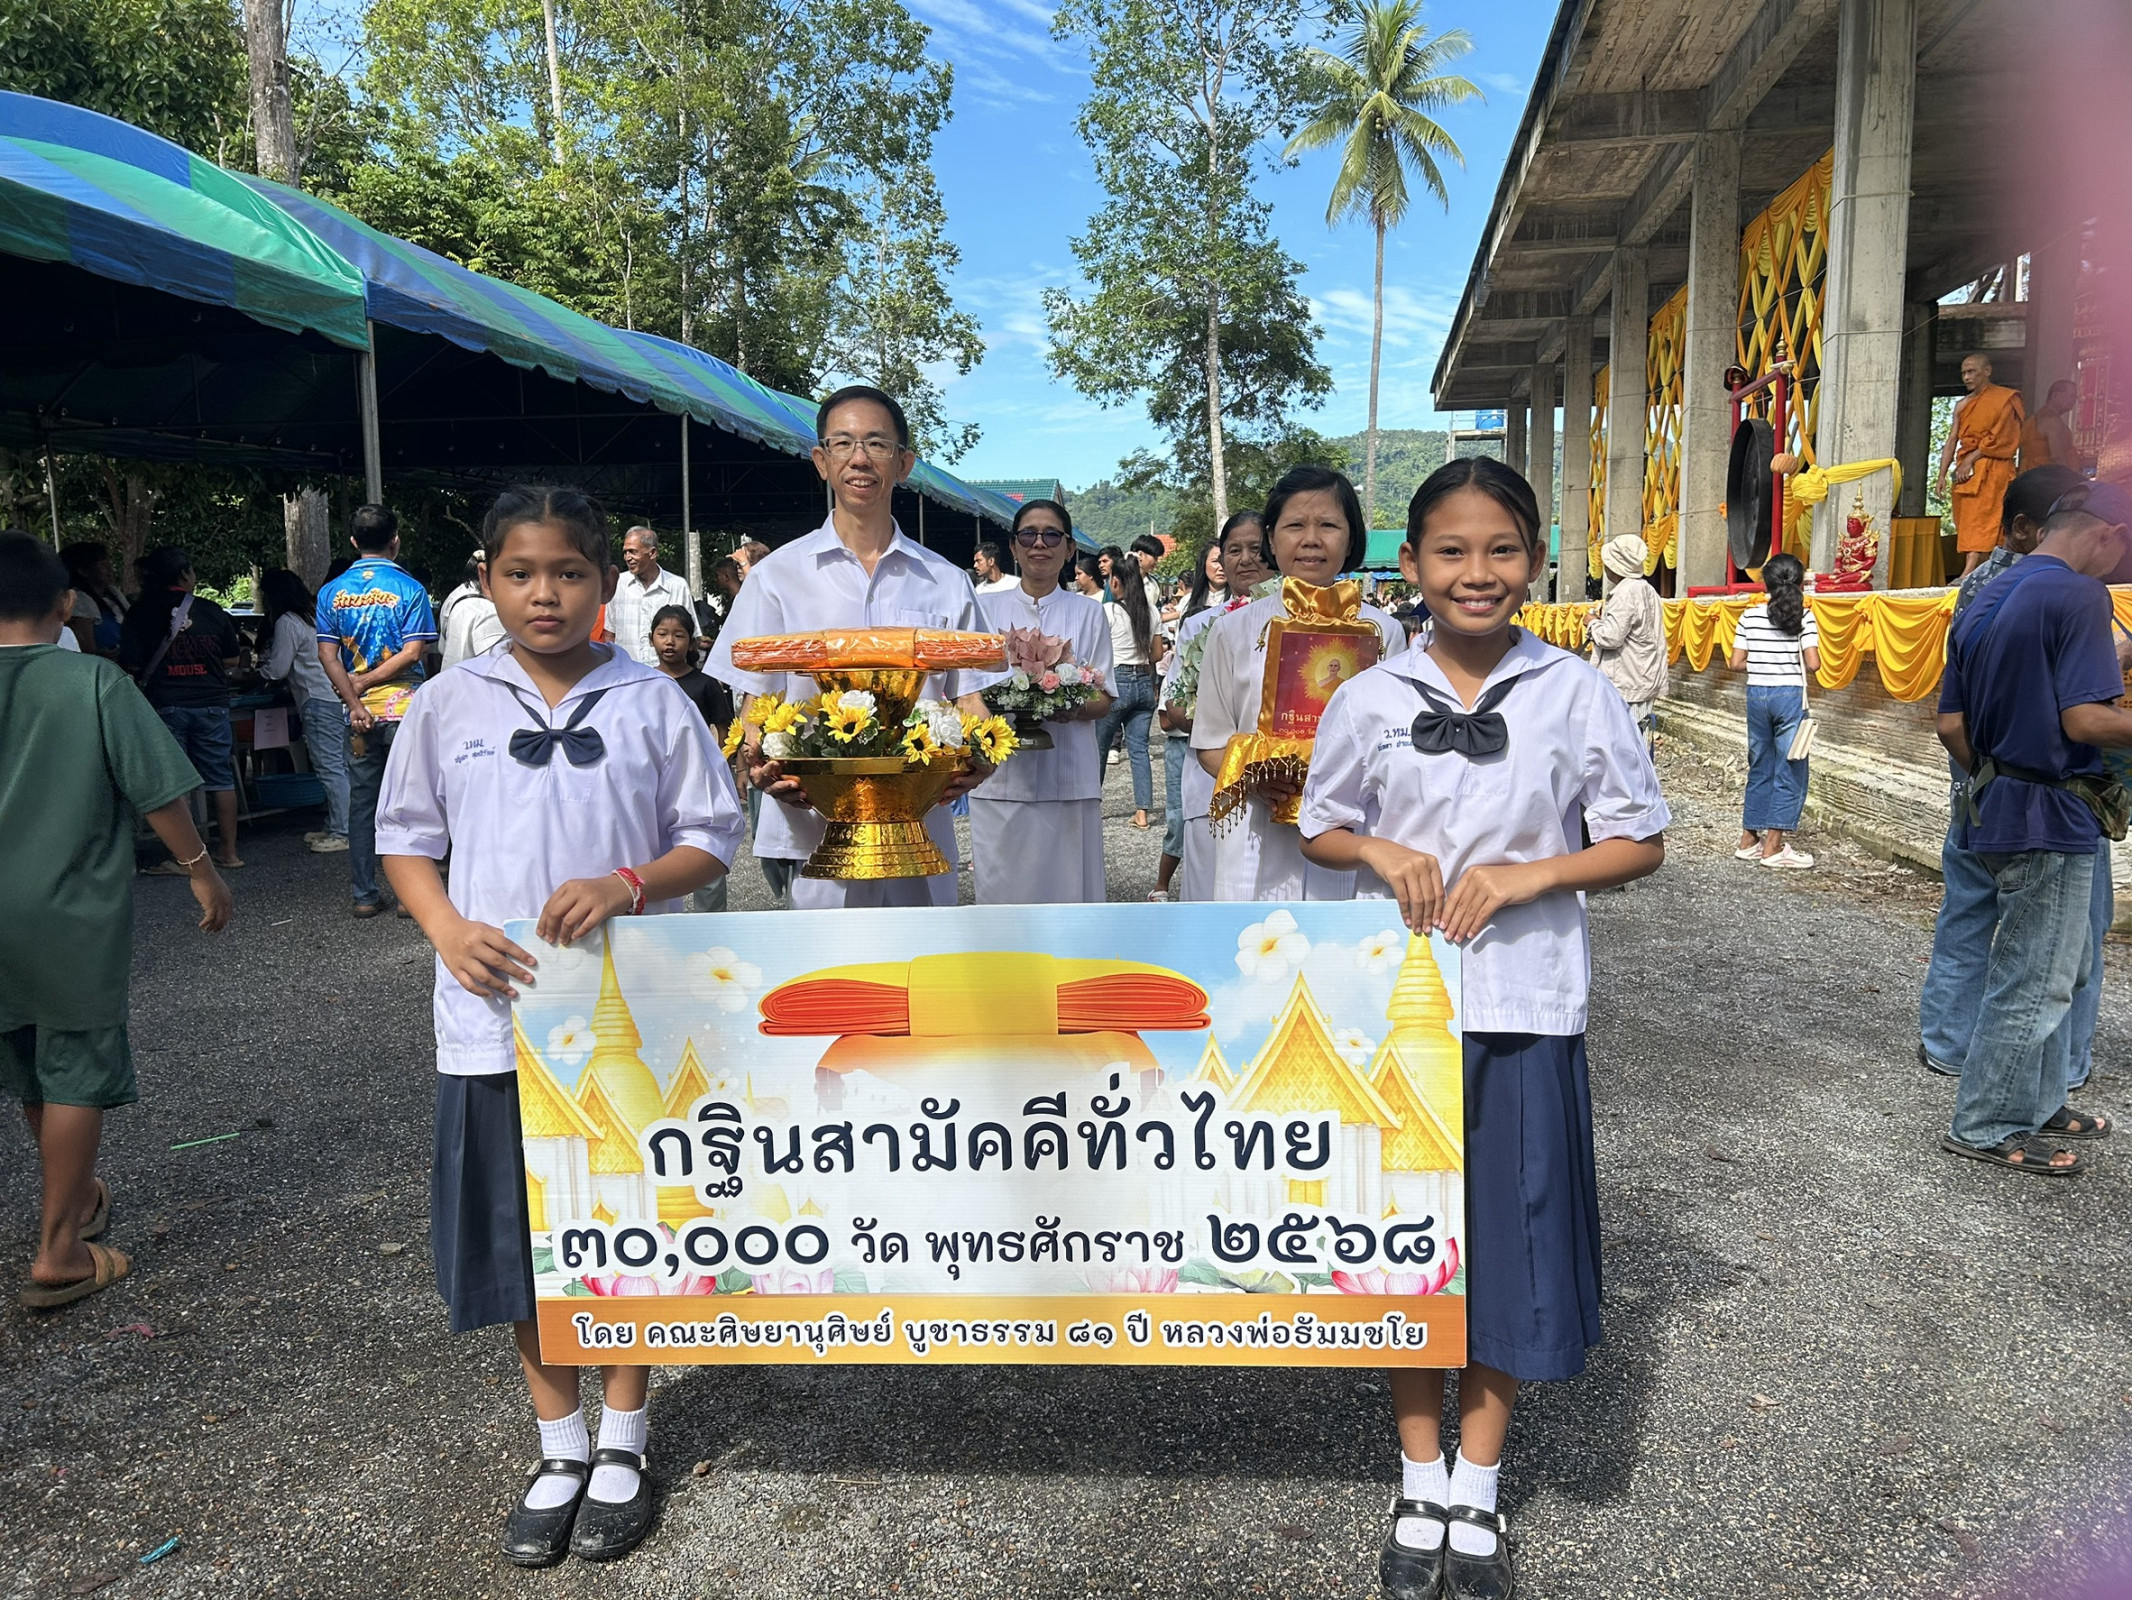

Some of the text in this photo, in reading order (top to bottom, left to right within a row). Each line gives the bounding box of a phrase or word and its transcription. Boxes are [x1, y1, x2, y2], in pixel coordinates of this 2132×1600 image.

[168, 664, 207, 676] MOUSE
[649, 1073, 1330, 1198] กฐินสามัคคีทั่วไทย
[562, 1213, 1435, 1281] ๓๐,๐๐๐ วัด พุทธศักราช ๒๕๖๘
[576, 1309, 1424, 1355] โดย คณะศิษยานุศิษย์ บูชาธรรม ๘๑ ปี หลวงพ่อธัมมชโย
